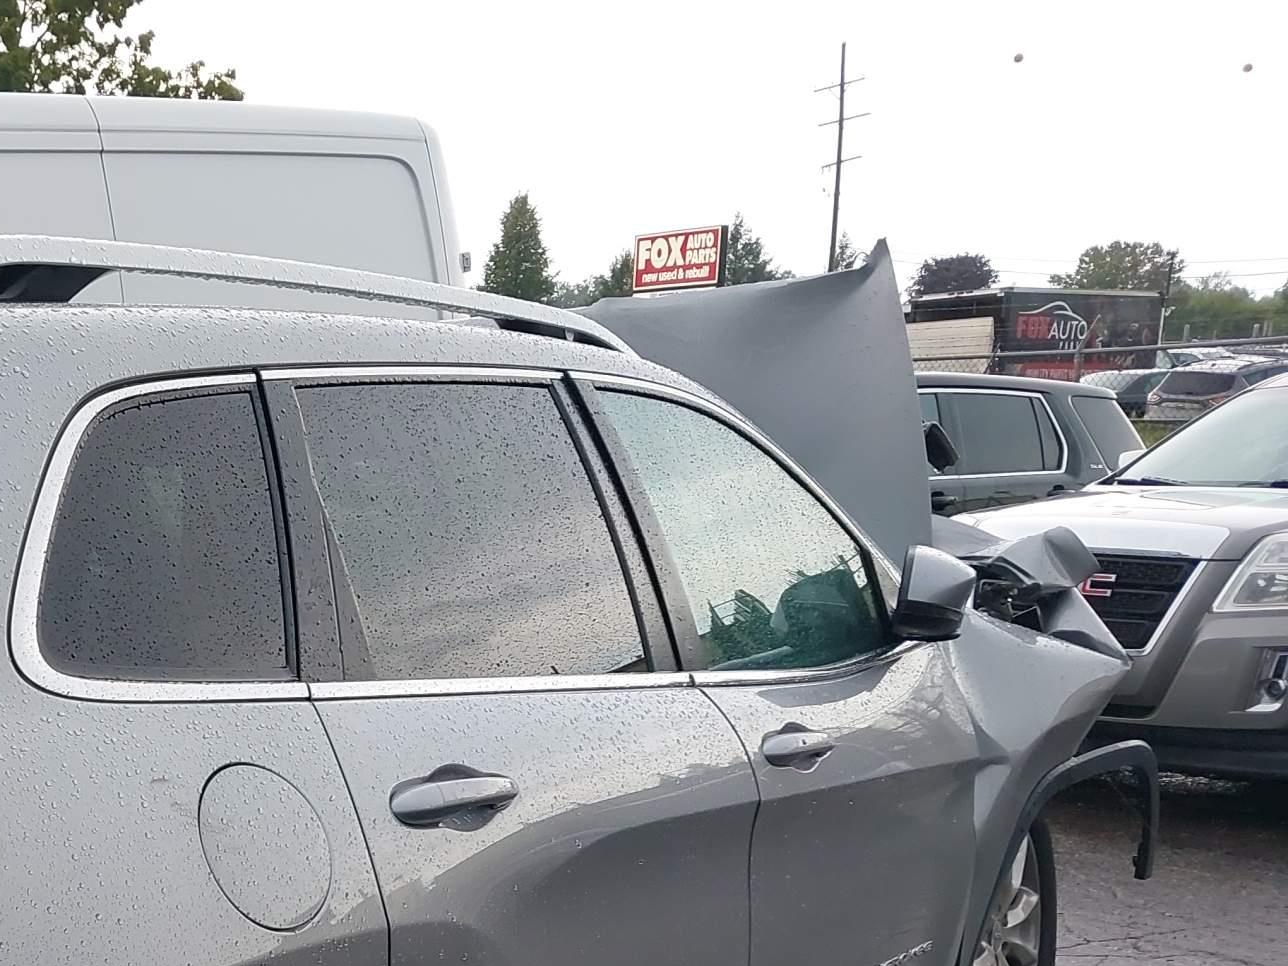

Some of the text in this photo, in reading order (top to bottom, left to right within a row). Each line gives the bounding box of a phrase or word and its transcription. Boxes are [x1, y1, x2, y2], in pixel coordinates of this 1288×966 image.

[686, 232, 715, 250] AUTO
[638, 236, 685, 270] FOX
[685, 247, 717, 266] PARTS
[642, 272, 658, 283] new
[659, 268, 678, 281] used
[1048, 320, 1088, 340] AUTO
